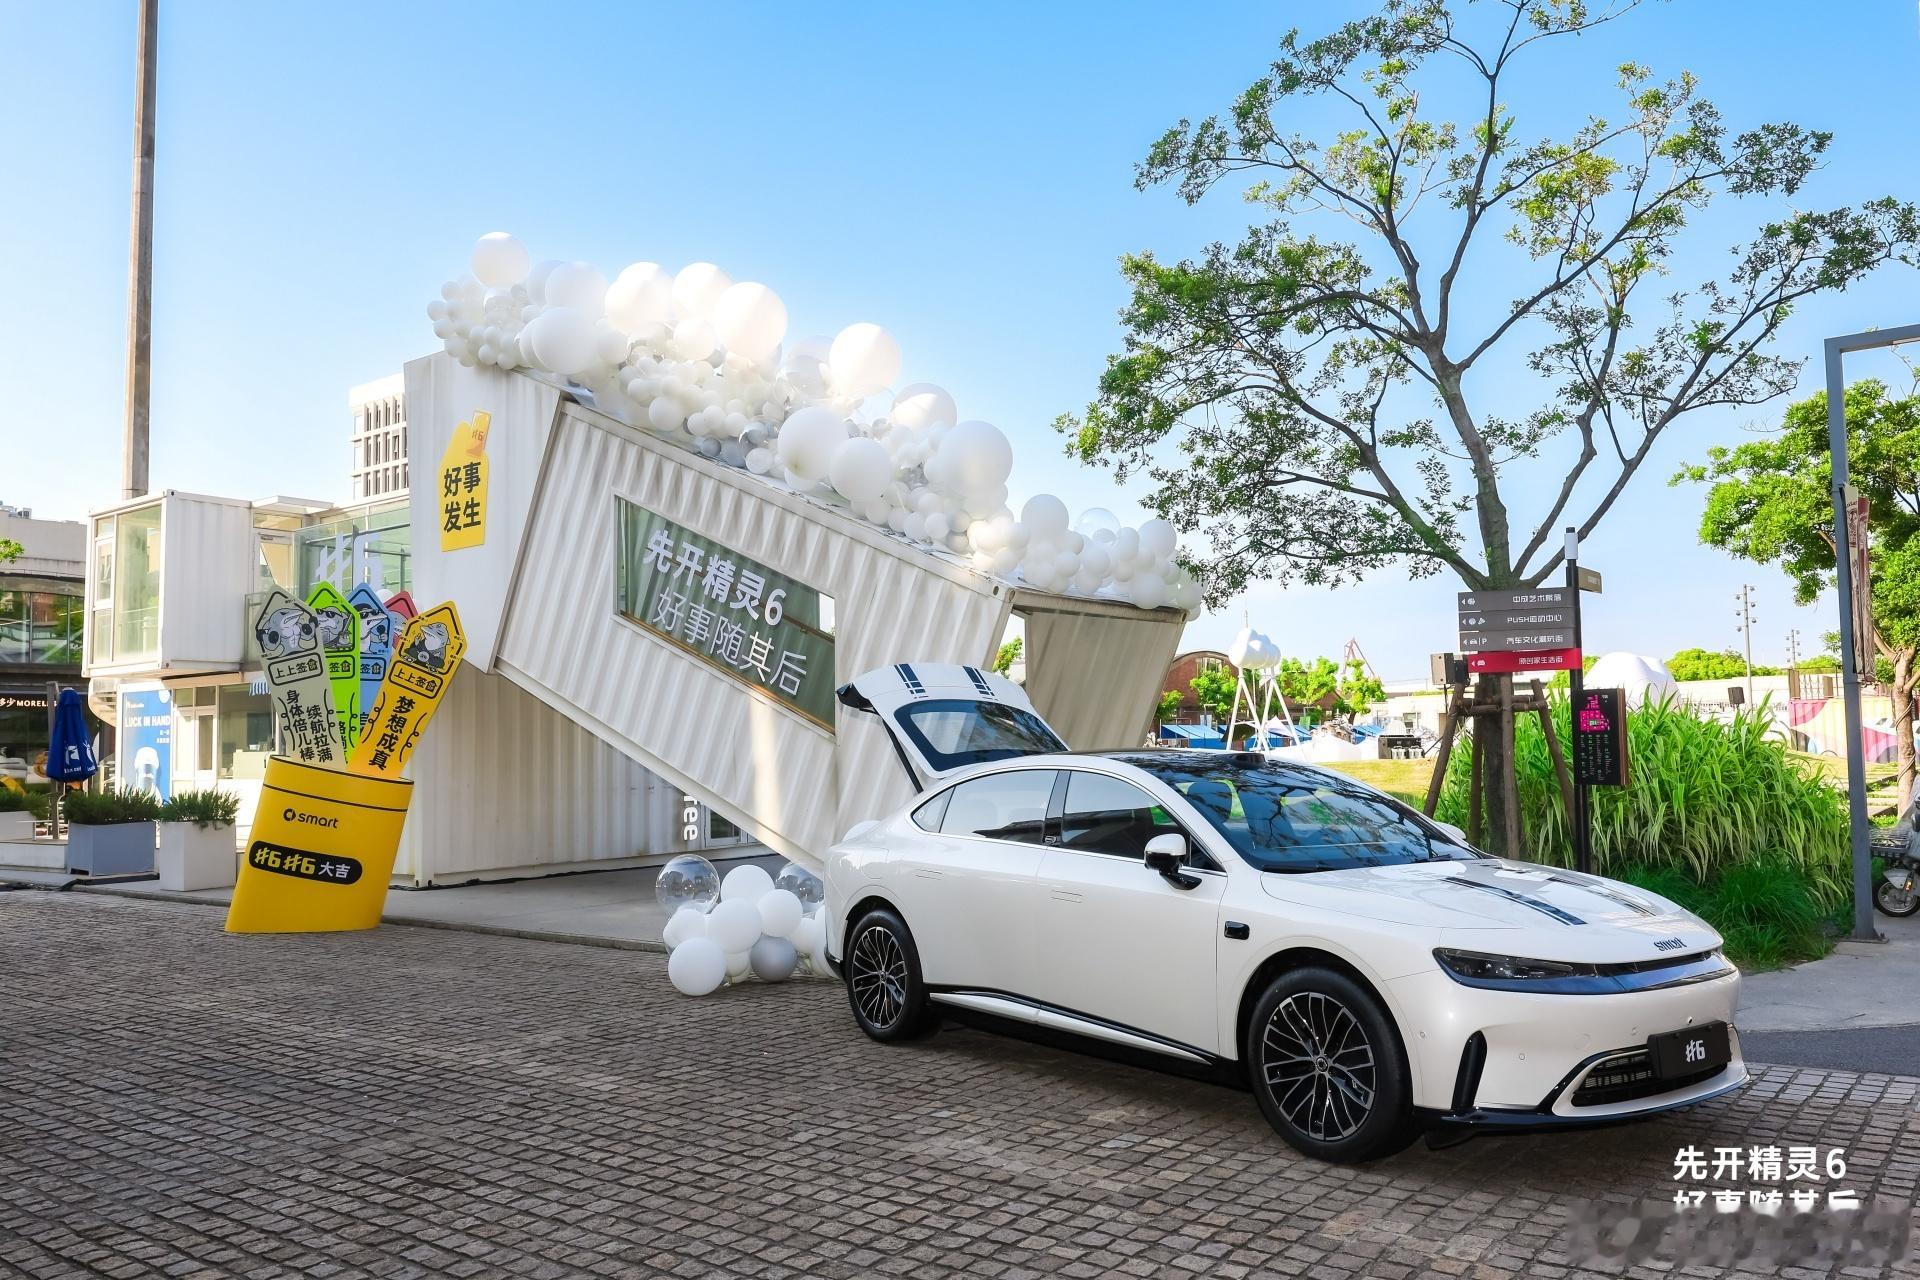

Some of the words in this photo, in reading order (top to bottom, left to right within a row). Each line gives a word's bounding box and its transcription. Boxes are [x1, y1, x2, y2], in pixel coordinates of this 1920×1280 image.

[444, 461, 481, 497] 好事
[444, 497, 481, 533] 发生
[644, 530, 787, 626] 先开精灵6
[653, 587, 807, 696] 好事随其后
[125, 716, 142, 728] LUCK
[143, 716, 151, 727] IN
[152, 715, 170, 727] HAND
[286, 690, 316, 763] 身体倍儿棒
[306, 704, 333, 763] 续航拉满
[369, 695, 416, 771] 梦想成真
[298, 812, 339, 829] smart
[1653, 937, 1687, 952] smart
[1685, 1040, 1706, 1063] #6
